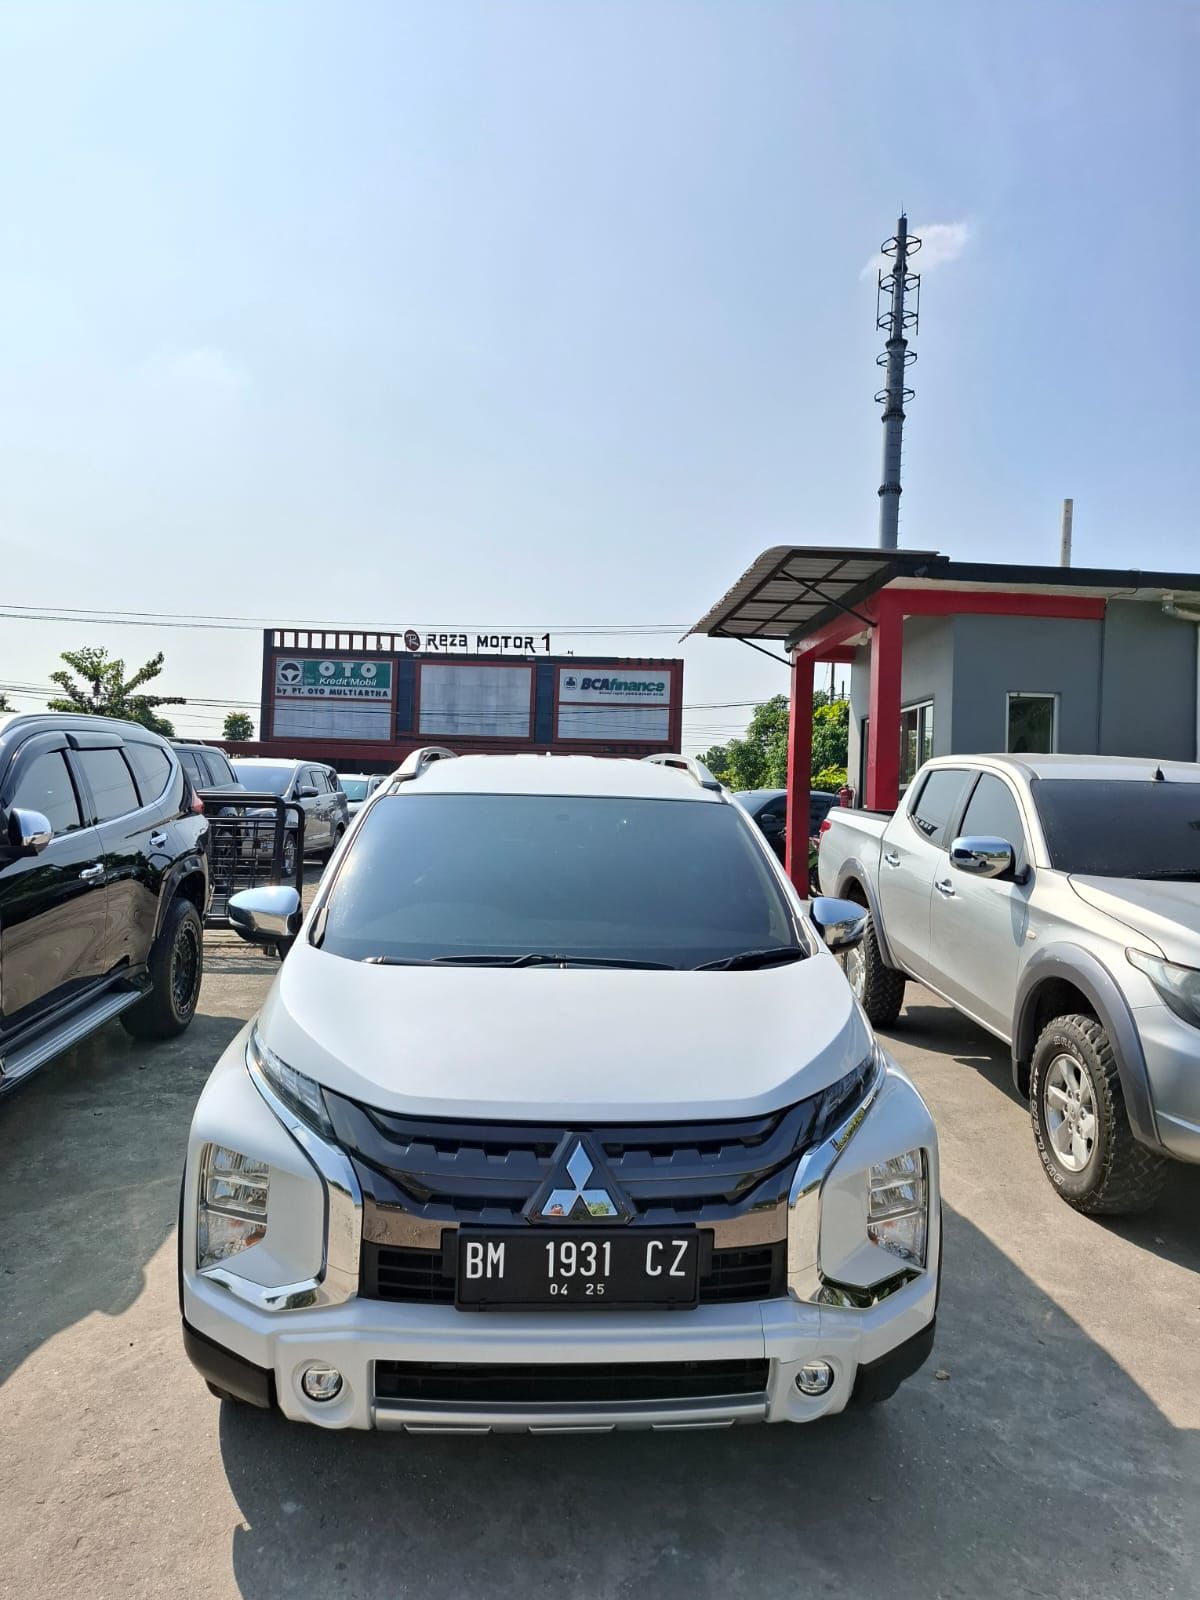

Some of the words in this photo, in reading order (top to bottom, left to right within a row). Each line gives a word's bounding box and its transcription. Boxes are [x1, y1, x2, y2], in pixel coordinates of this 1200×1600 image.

[477, 635, 536, 653] MOTOR
[542, 633, 550, 651] 1
[319, 661, 377, 678] OTO
[319, 677, 347, 685] Kredit
[350, 678, 377, 686] Mobil
[276, 687, 287, 695] by
[291, 687, 304, 695] PT.
[307, 688, 326, 696] OTO
[329, 689, 389, 697] MULTIARTHA
[466, 1242, 505, 1278] BM
[546, 1241, 611, 1278] 1931
[645, 1240, 688, 1276] CZ
[550, 1283, 568, 1295] 04
[585, 1283, 605, 1295] 25
